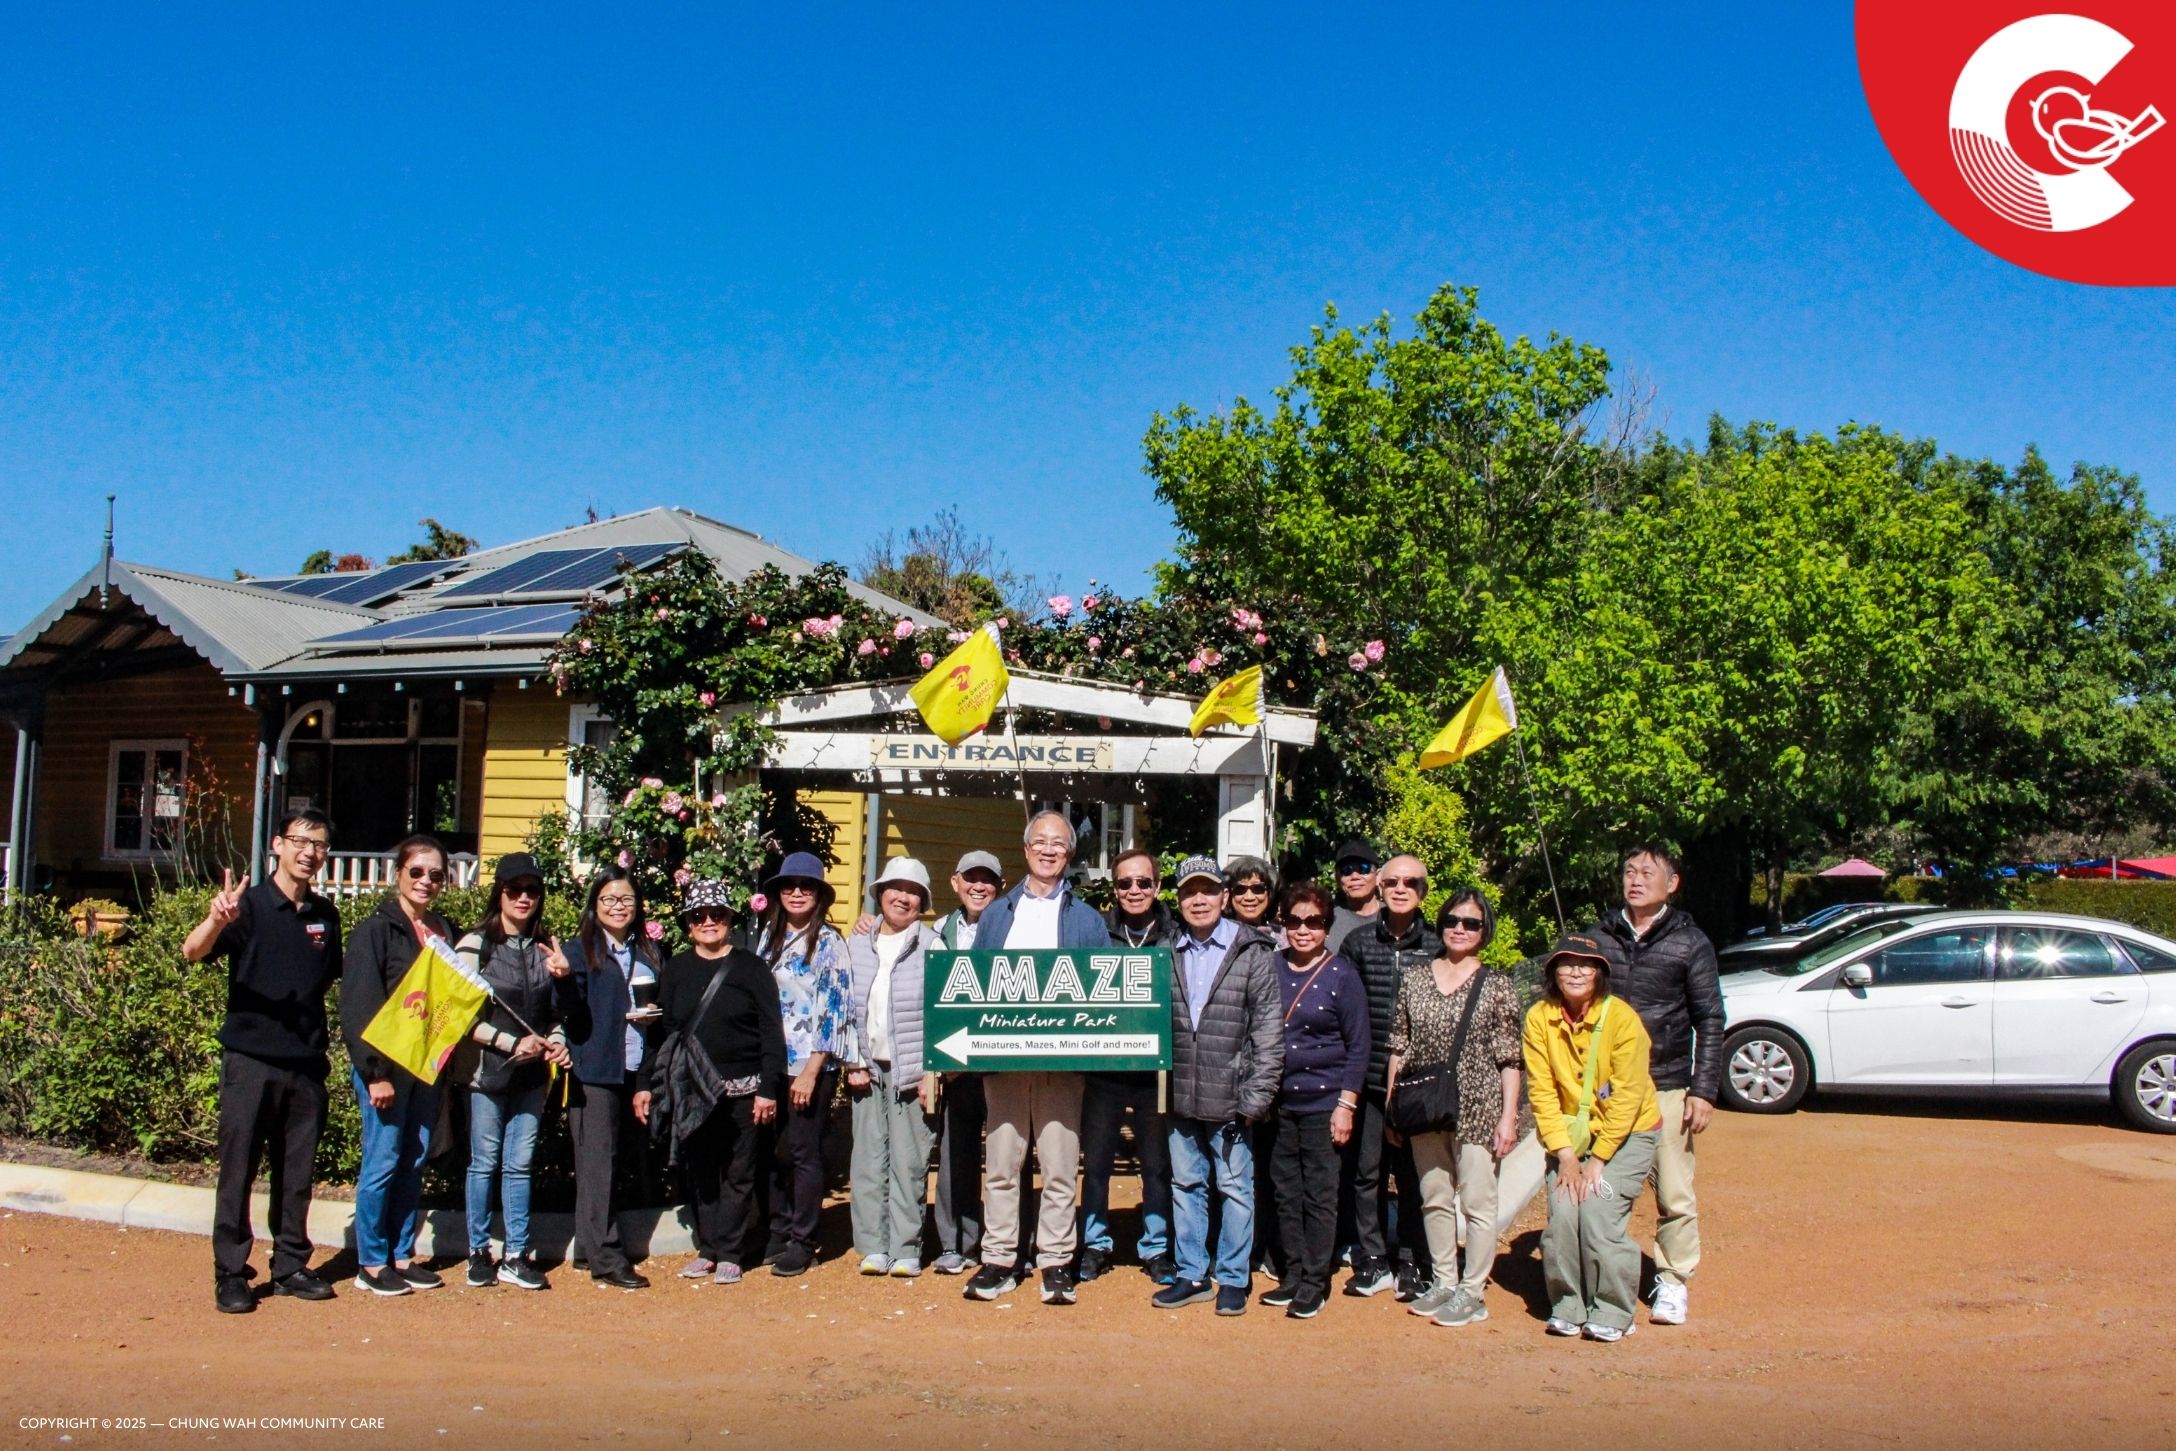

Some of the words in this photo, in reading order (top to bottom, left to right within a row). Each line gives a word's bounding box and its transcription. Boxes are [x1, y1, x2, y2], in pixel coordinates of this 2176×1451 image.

[889, 744, 1096, 763] ENTRANCE
[939, 955, 1152, 1002] AMAZE
[979, 1013, 1066, 1028] Miniature
[1073, 1012, 1118, 1027] Park
[971, 1040, 1023, 1051] Miniatures,
[1025, 1040, 1057, 1050] Mazes,
[1059, 1039, 1080, 1049] Mini
[1081, 1039, 1101, 1049] Golf
[1102, 1039, 1121, 1049] and
[1123, 1039, 1151, 1049] more!
